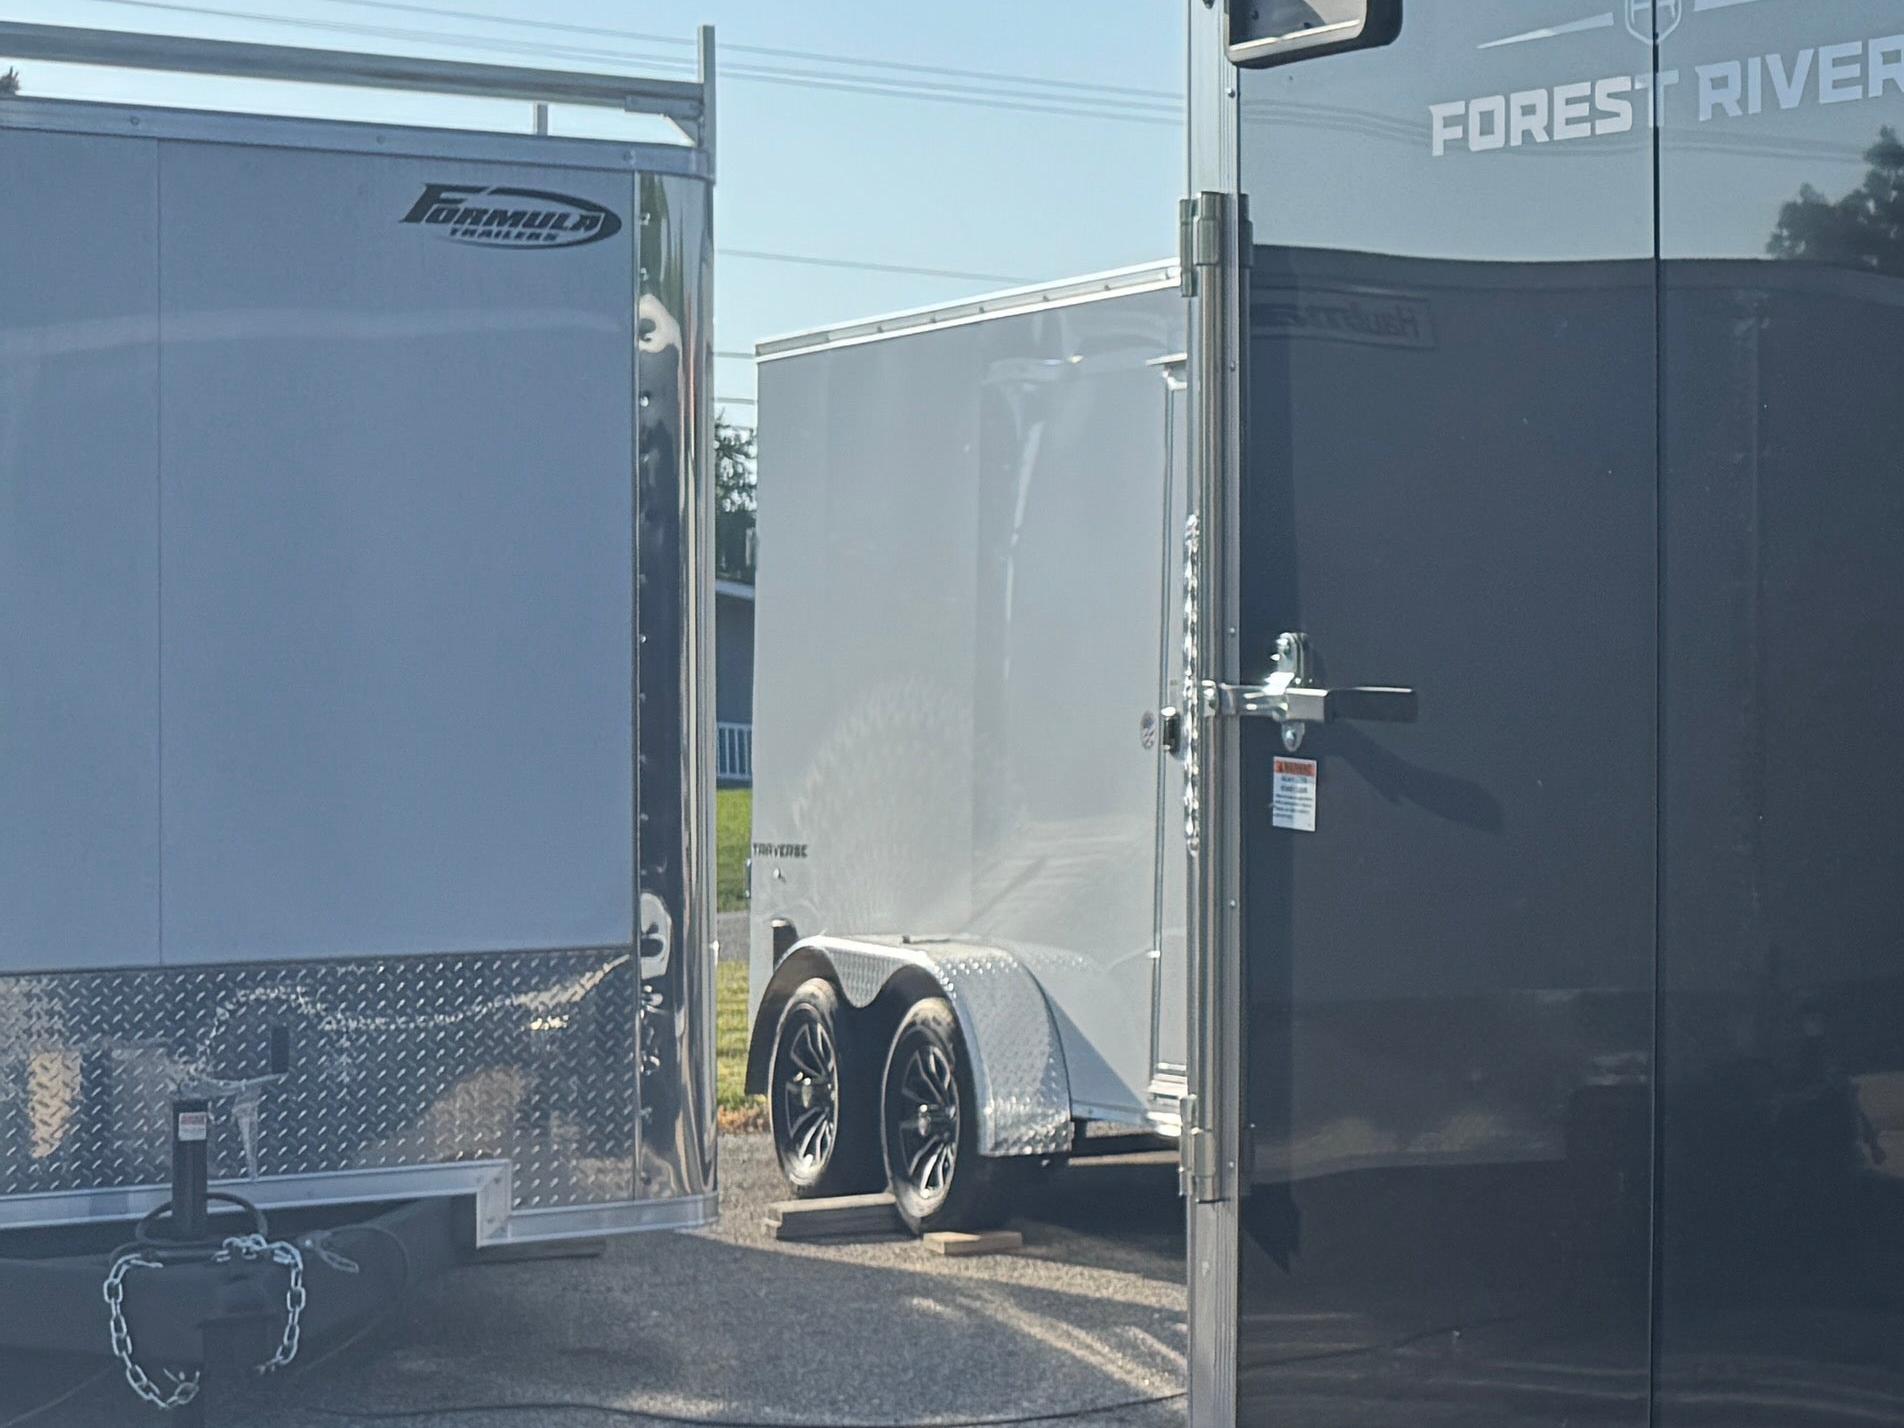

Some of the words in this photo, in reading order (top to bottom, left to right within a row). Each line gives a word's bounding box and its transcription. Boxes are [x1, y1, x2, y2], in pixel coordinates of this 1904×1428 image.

[1428, 69, 1680, 157] FOREST
[399, 183, 605, 232] FORMULA
[450, 227, 559, 242] TRAILERS
